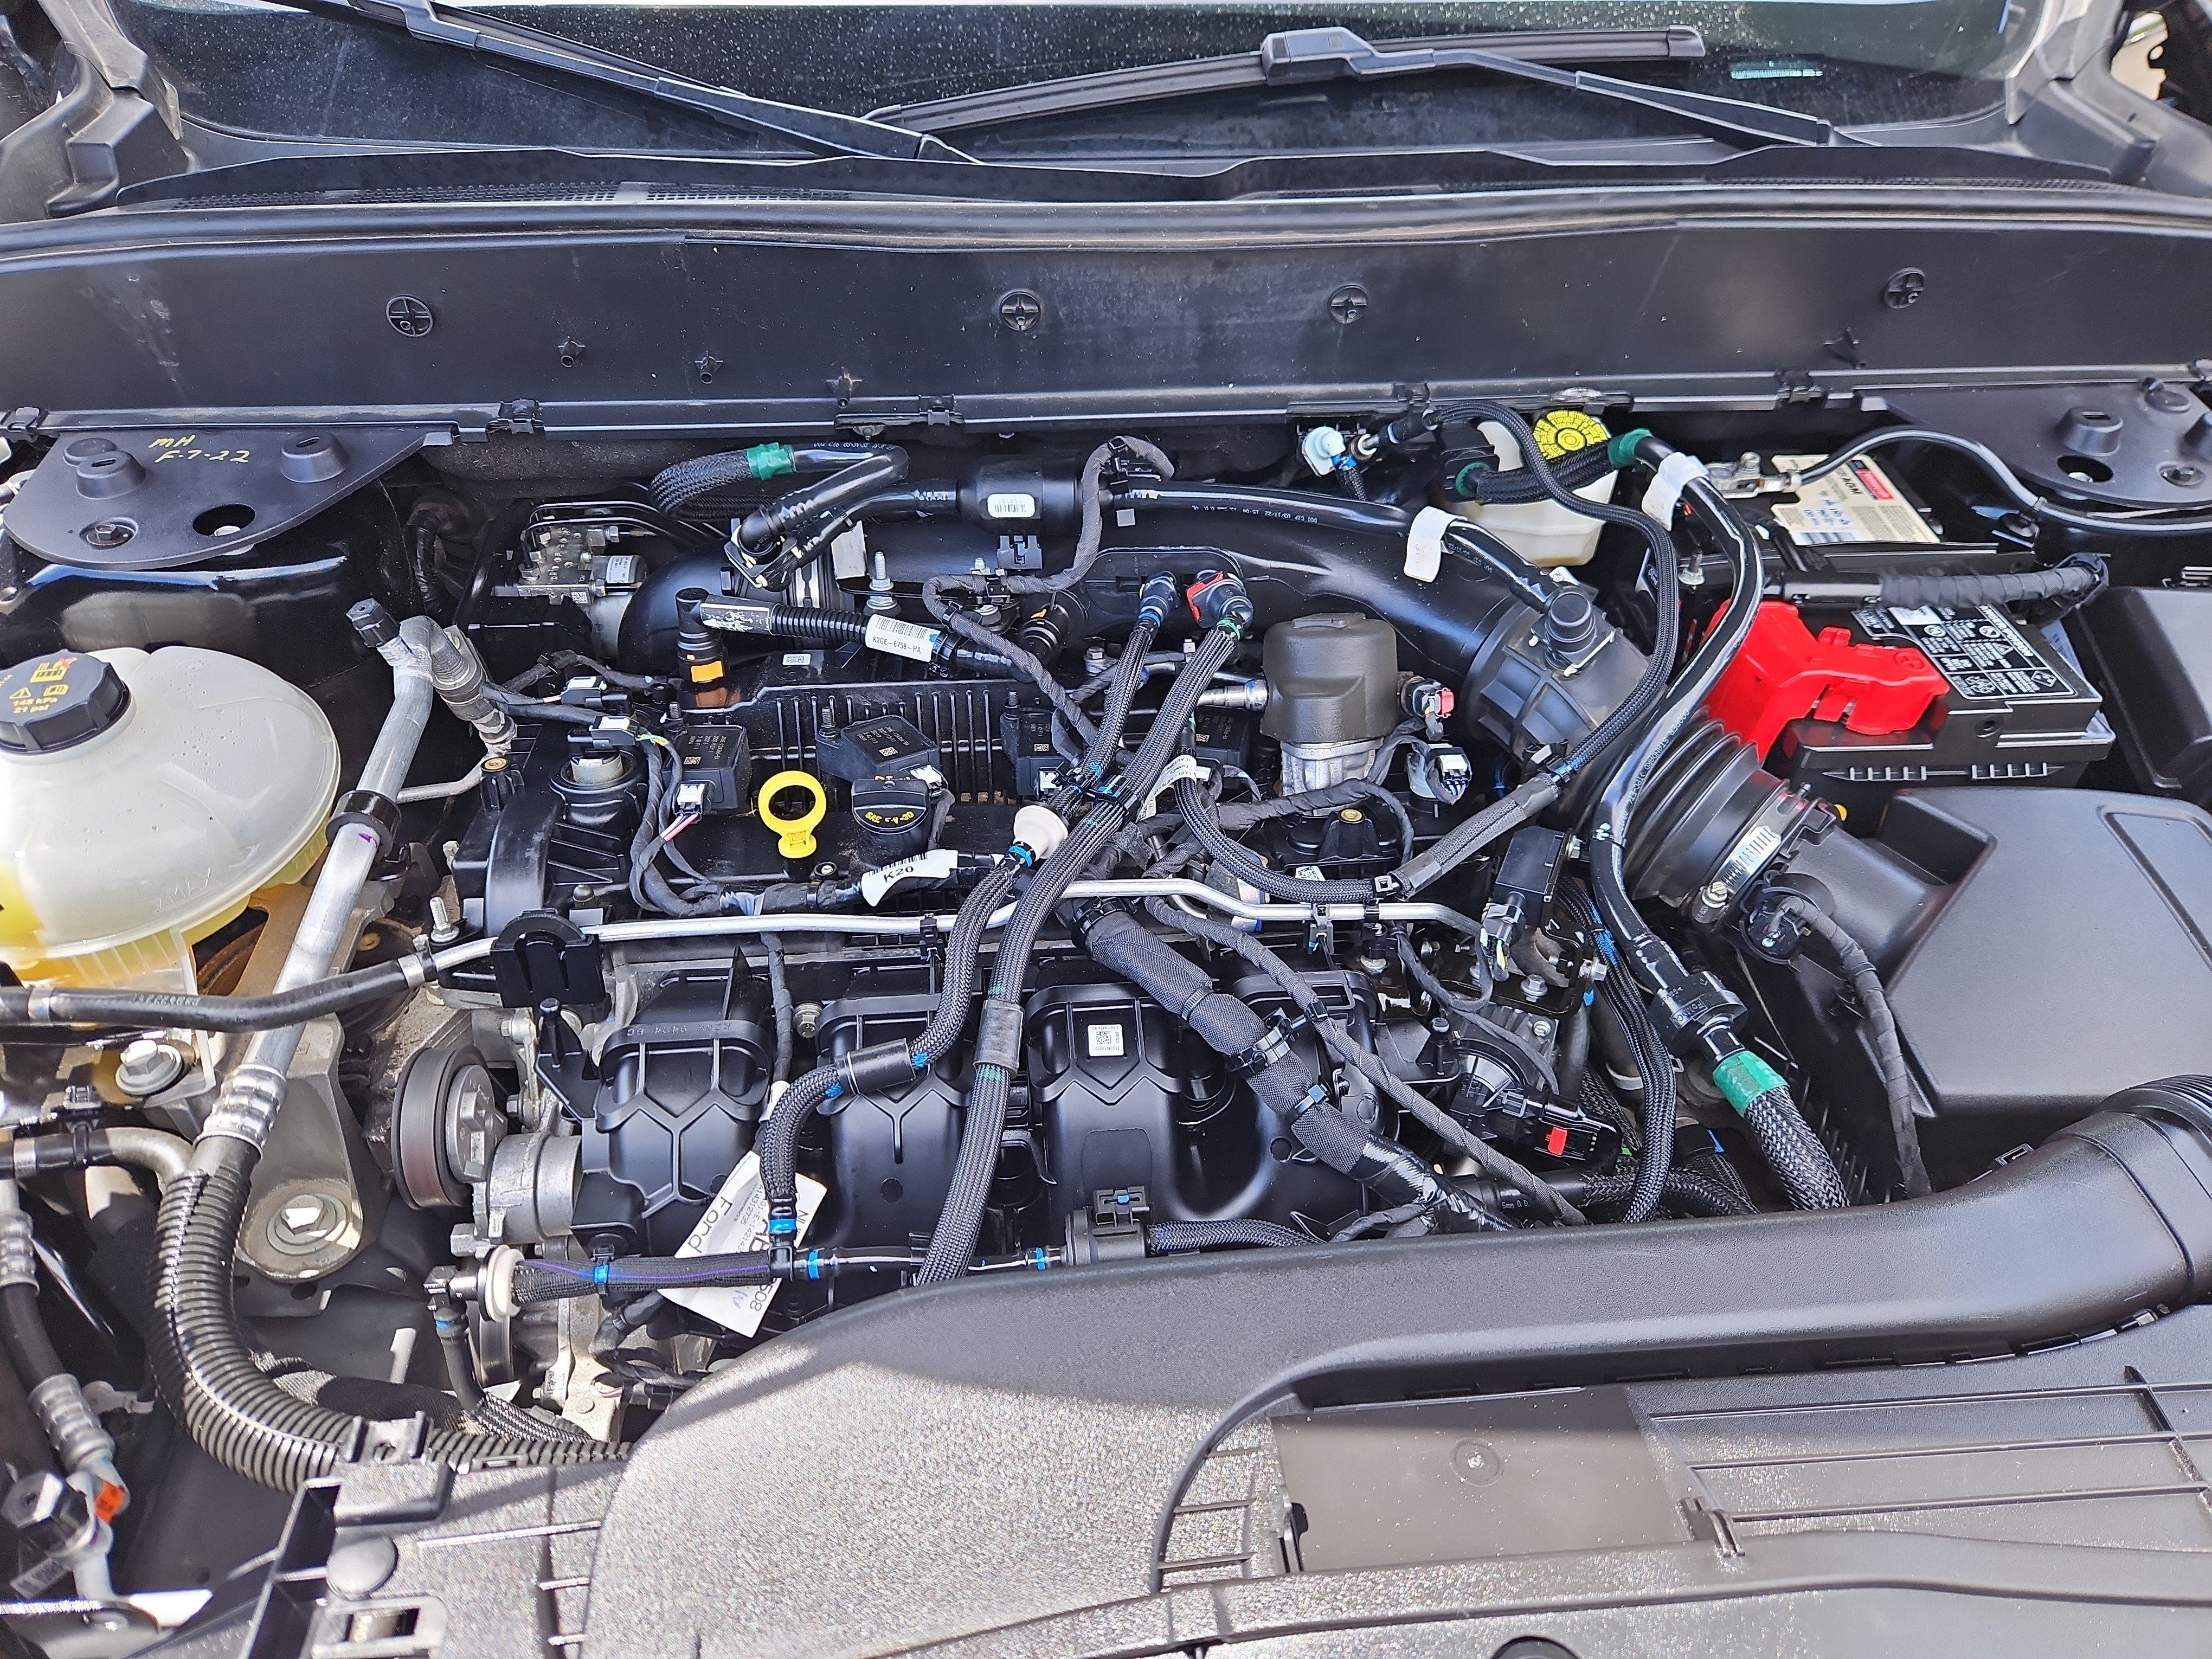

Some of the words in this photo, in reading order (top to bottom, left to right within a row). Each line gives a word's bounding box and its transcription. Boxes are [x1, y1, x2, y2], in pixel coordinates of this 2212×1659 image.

[1978, 605, 2034, 657] ANGER/POISON
[1670, 709, 1690, 736] COOPER
[1644, 737, 1670, 770] STANDARD
[883, 866, 914, 883] K20
[687, 1196, 732, 1254] Ford
